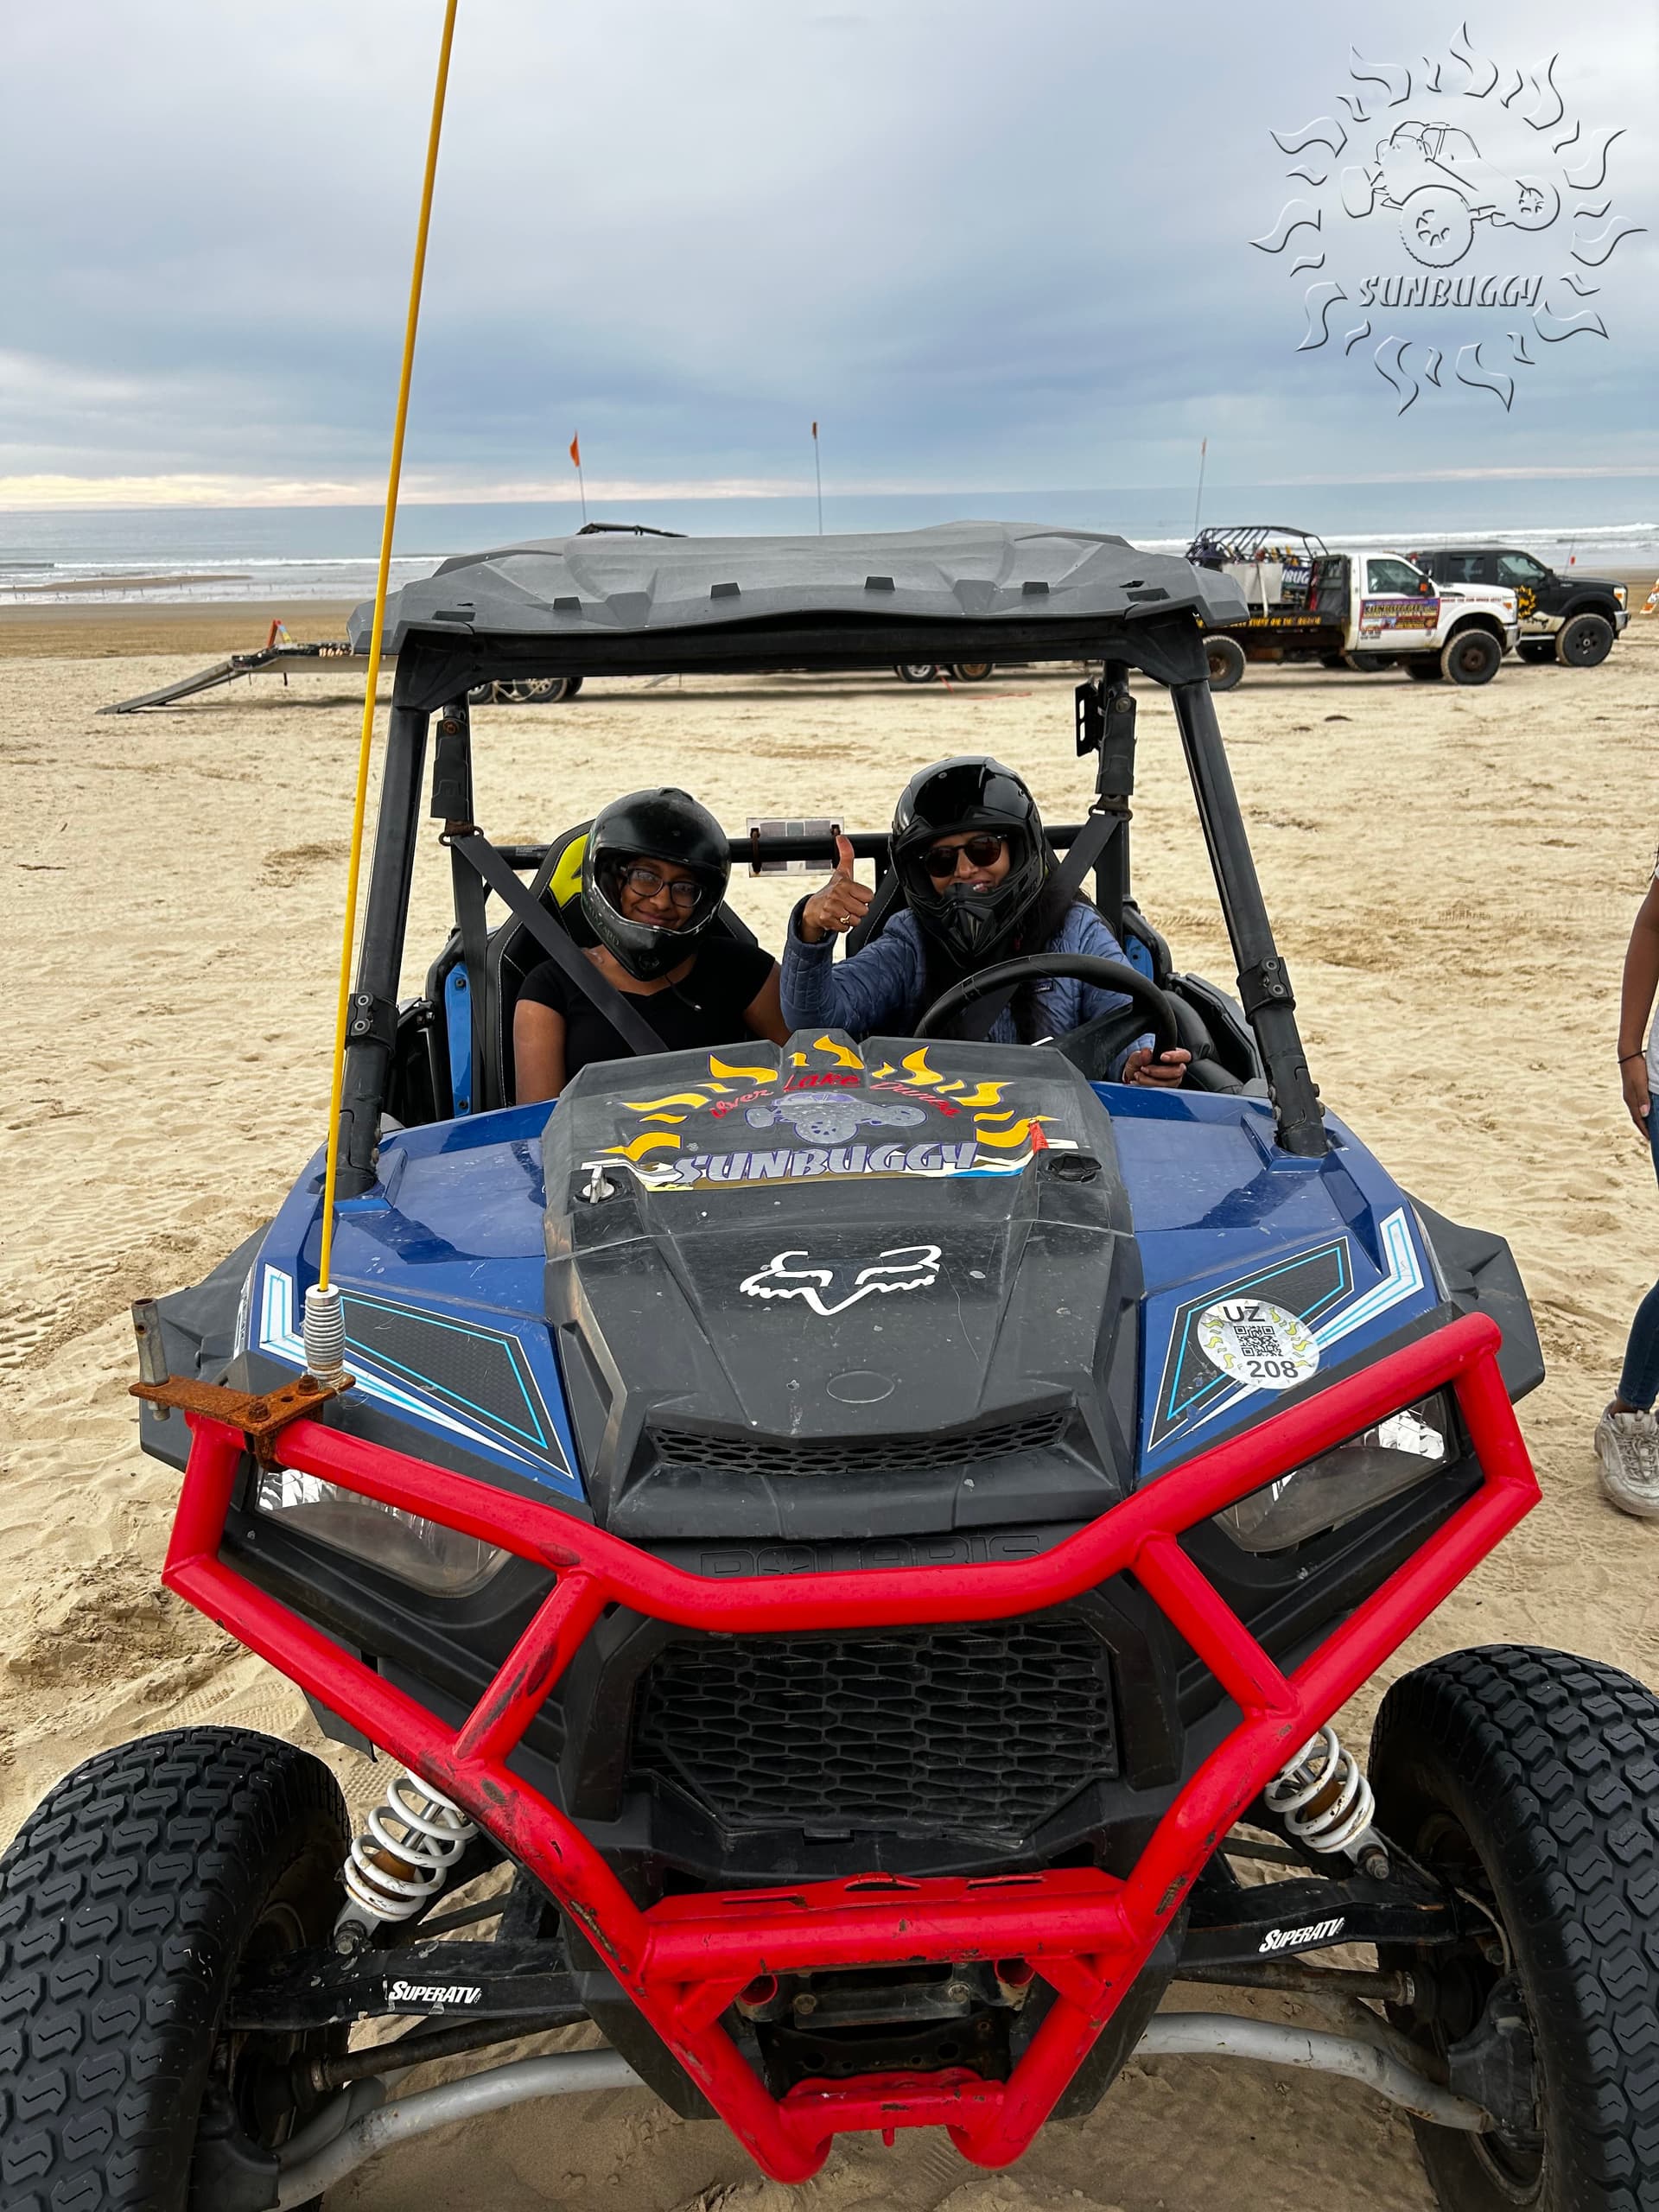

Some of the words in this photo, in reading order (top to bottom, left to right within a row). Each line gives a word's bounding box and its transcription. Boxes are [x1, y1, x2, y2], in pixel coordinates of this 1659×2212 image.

[783, 1071, 860, 1092] Lake
[673, 1141, 978, 1184] SUNBUGGY
[1223, 1306, 1265, 1322] UZ
[1247, 1360, 1298, 1378] 208
